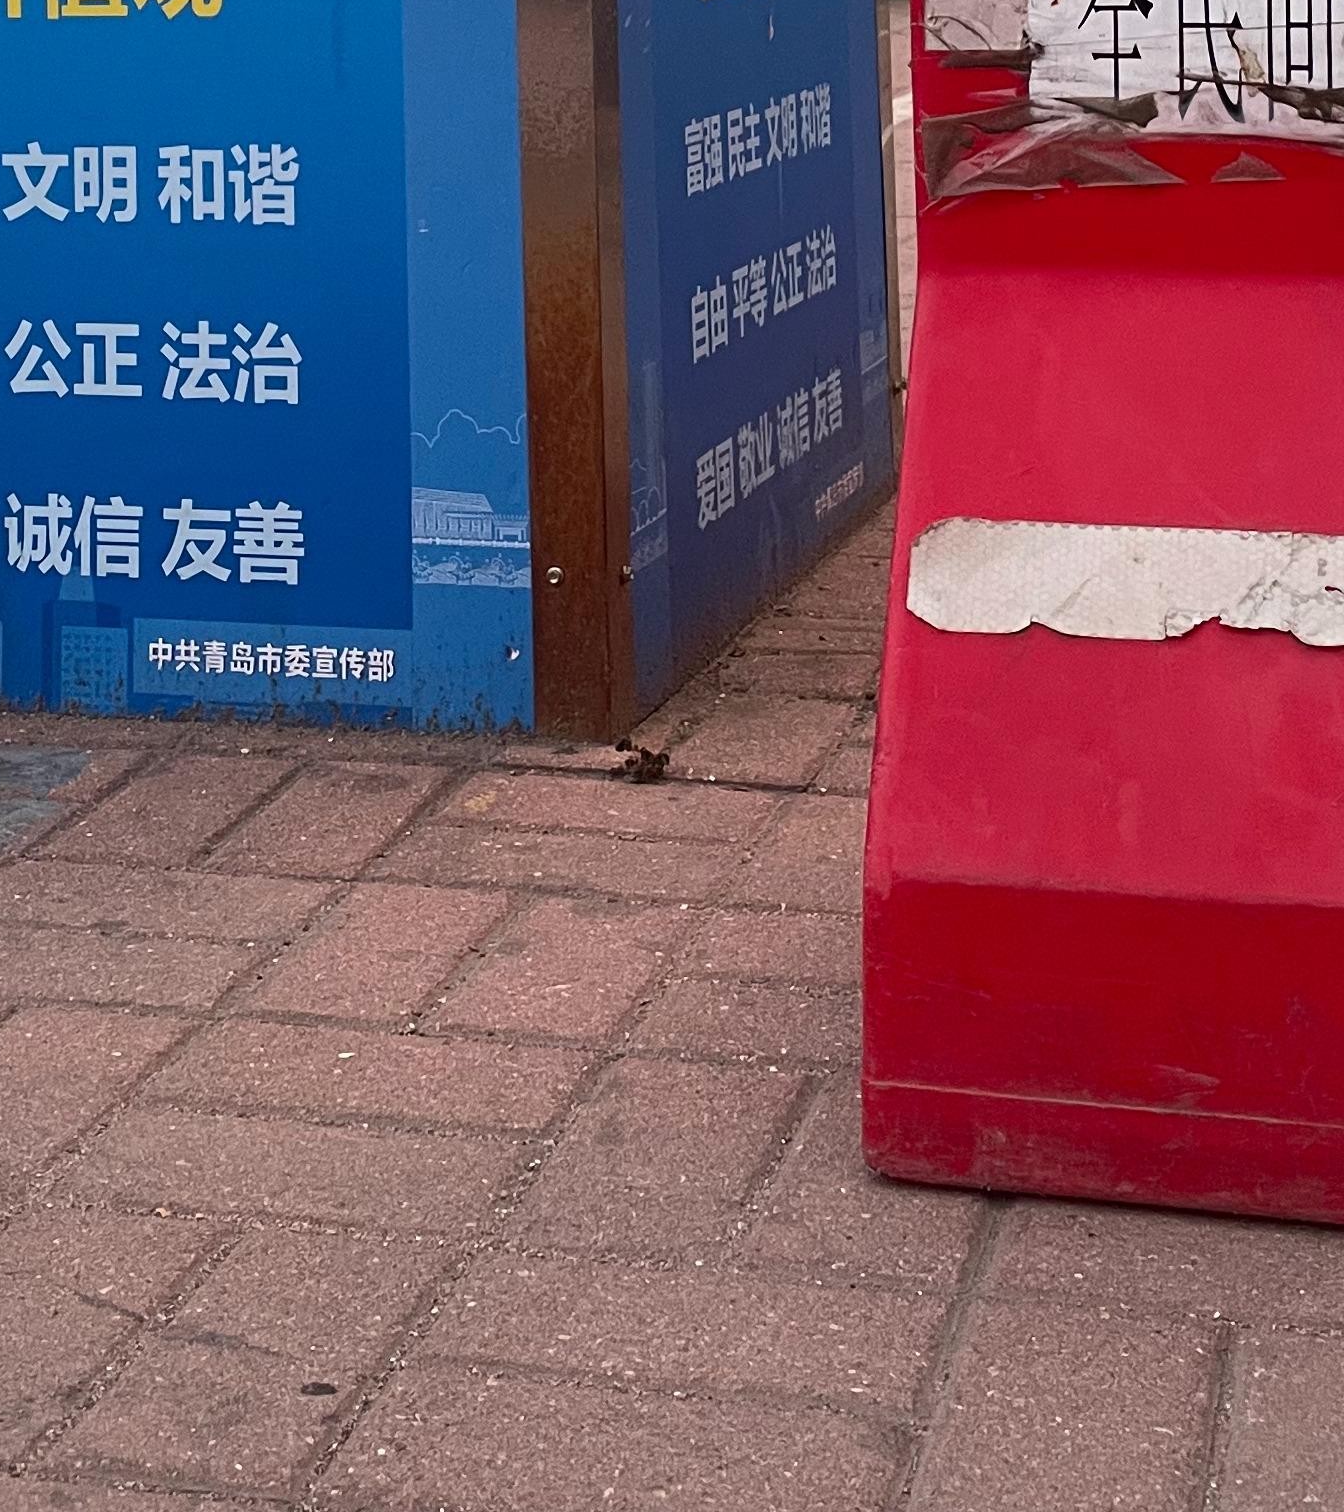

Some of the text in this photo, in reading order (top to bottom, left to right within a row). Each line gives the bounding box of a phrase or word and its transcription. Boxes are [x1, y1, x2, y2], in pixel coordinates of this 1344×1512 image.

[1, 141, 138, 223] 文明
[157, 143, 300, 226] 和谐
[685, 82, 832, 197] 富强 民主 文明 和谐
[690, 223, 838, 364] 自由 平等 公正 法治
[4, 319, 143, 398] 公正
[160, 320, 302, 405] 法治
[696, 435, 735, 531] 爱国
[736, 412, 775, 500] 敬业
[776, 386, 811, 470] 诚信
[812, 367, 843, 445] 友善
[4, 493, 143, 578] 诚信
[161, 498, 306, 586] 友善
[148, 637, 396, 683] 中共青岛市委宣传部
